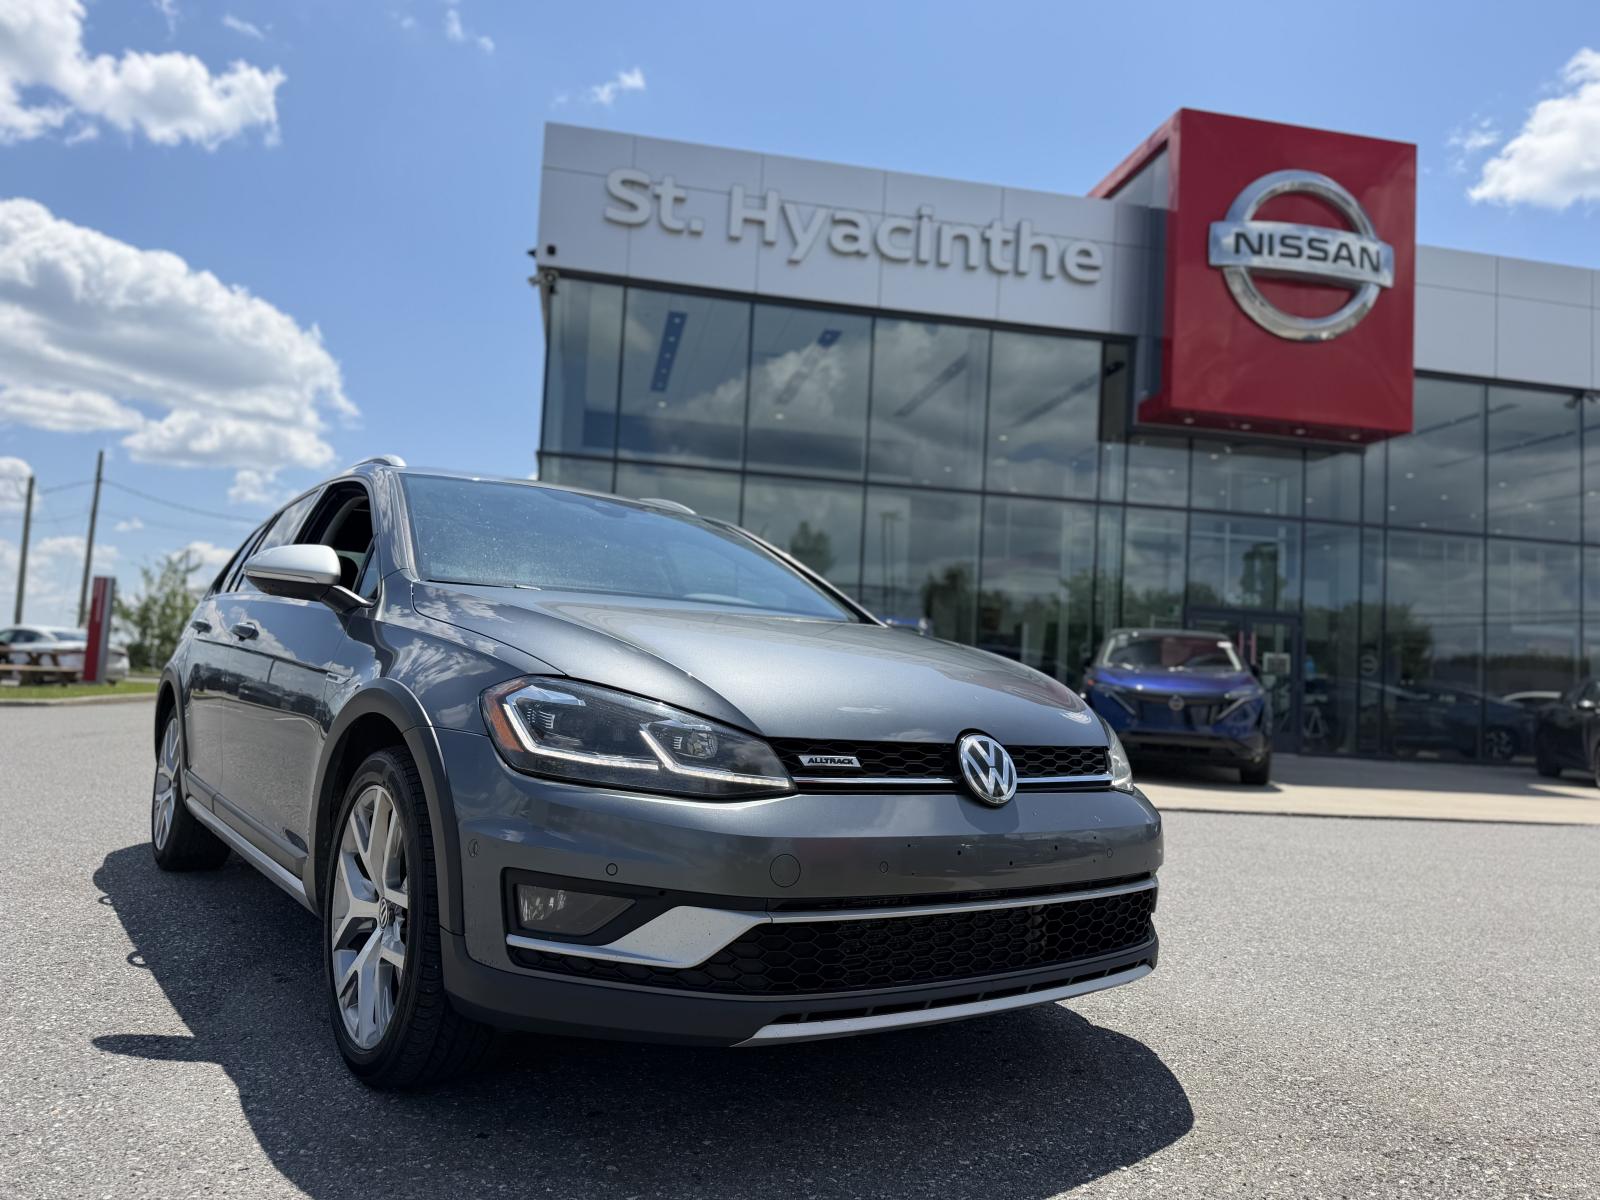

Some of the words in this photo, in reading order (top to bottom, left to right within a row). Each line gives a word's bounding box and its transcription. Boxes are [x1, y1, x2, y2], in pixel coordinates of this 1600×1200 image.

[604, 168, 704, 237] St.
[728, 184, 1103, 285] Hyacinthe
[1233, 231, 1382, 273] NISSAN
[806, 756, 855, 766] ALLTRACK
[961, 736, 1013, 800] VW
